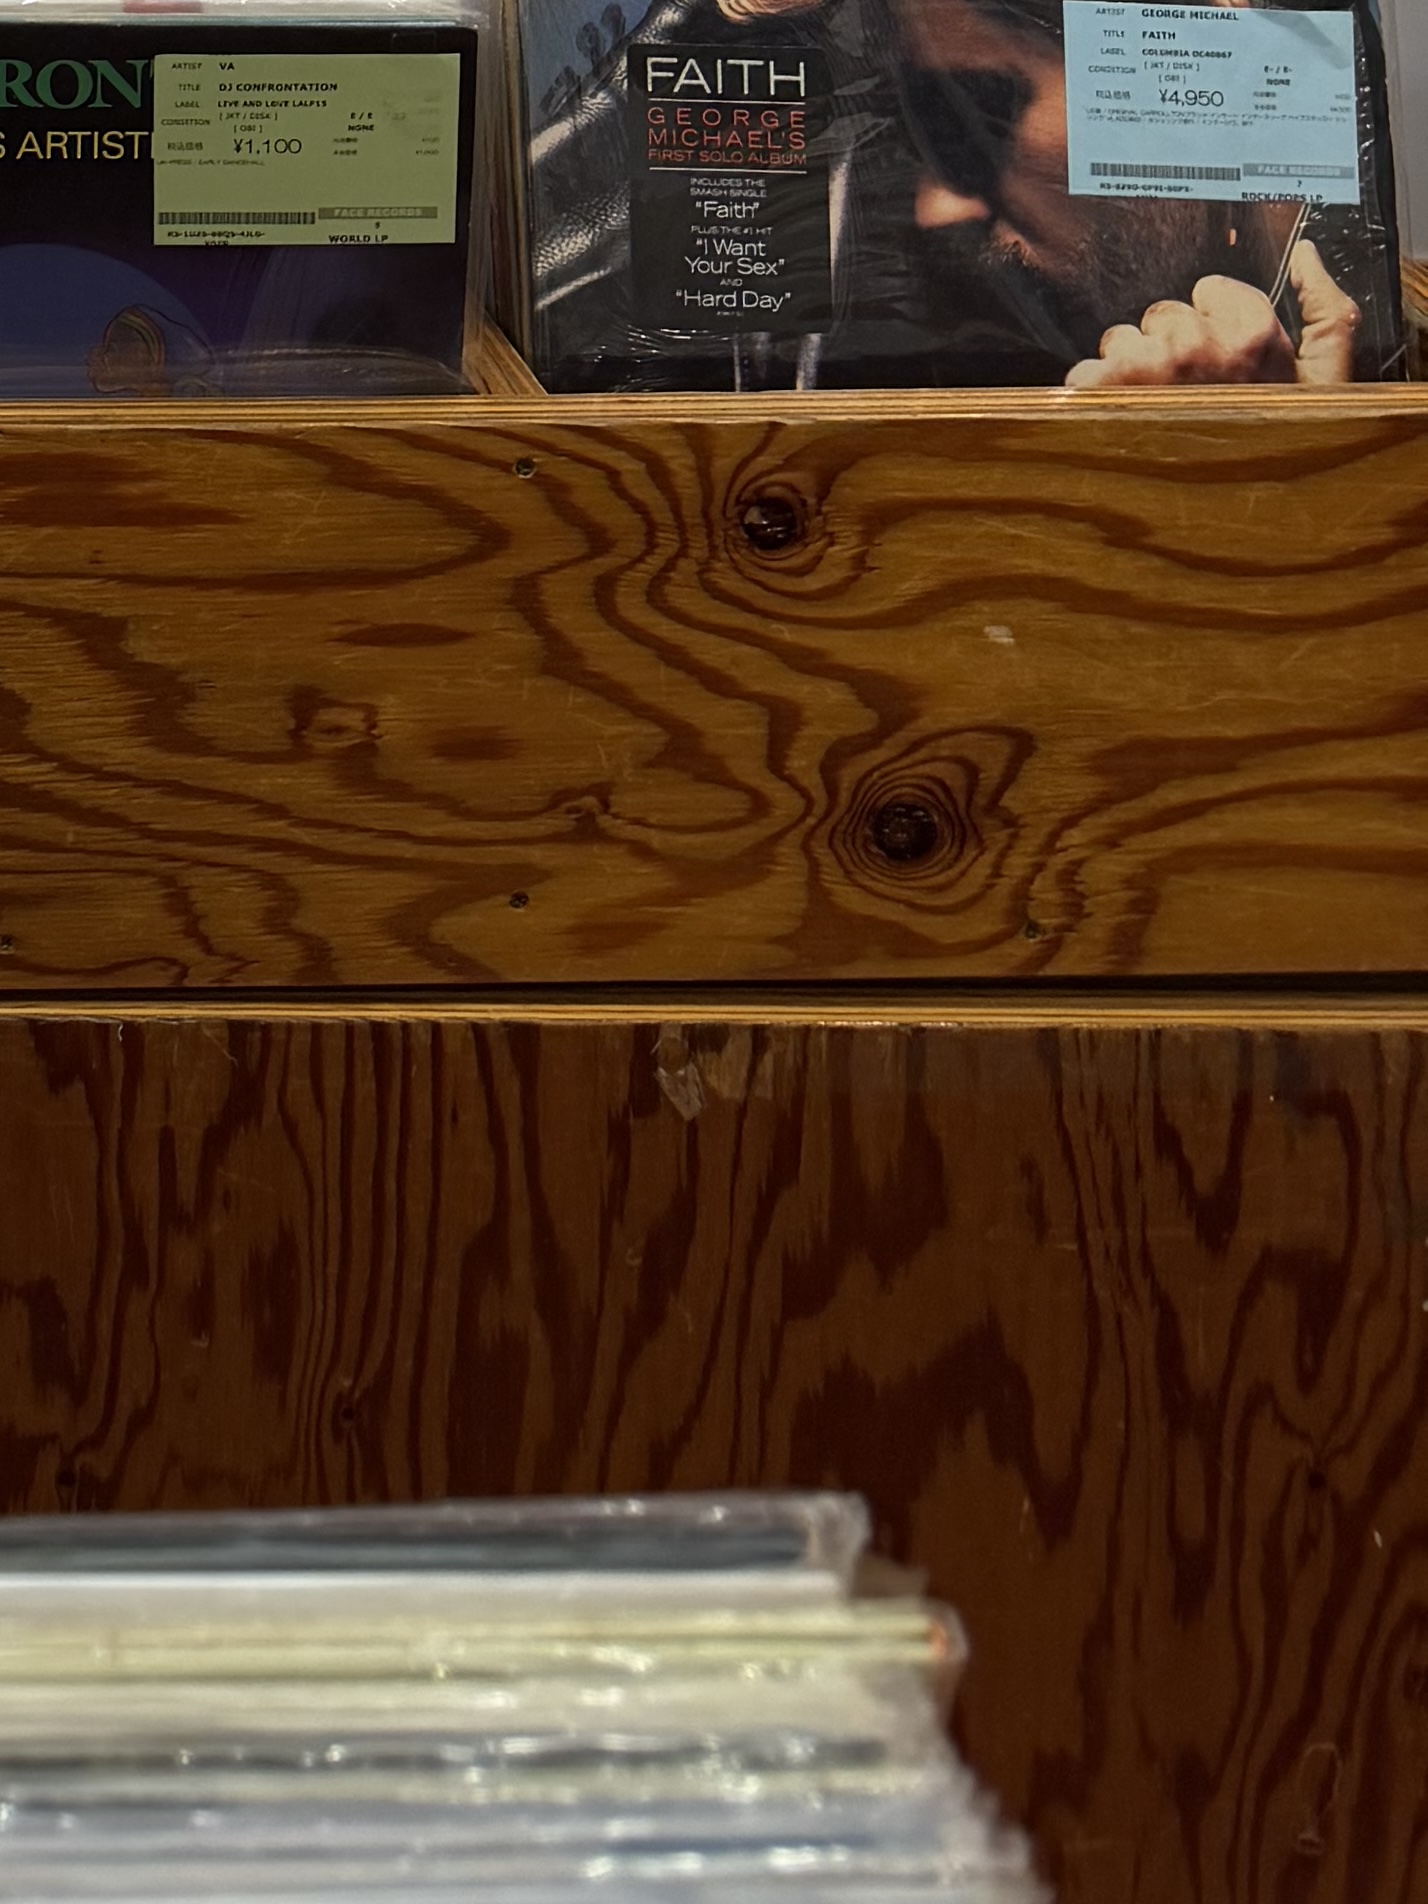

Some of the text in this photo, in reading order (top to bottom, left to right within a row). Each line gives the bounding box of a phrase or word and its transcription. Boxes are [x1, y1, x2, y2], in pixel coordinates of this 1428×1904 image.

[1141, 8, 1239, 21] GEORGE MICHAEL
[1141, 30, 1176, 40] FAITH
[1141, 48, 1190, 58] COLUMBIA
[219, 62, 235, 71] VA
[646, 56, 806, 97] FAITH
[218, 82, 338, 92] DJ CONFRONTATION
[242, 100, 263, 109] AND
[1158, 89, 1224, 108] ¥4,950
[647, 106, 806, 129] GEORGE
[15, 130, 155, 161] ARTIST
[647, 128, 806, 151] MICHAEL'S
[233, 138, 303, 155] ¥1,100
[648, 149, 807, 165] FIRST SOLO ALBUM
[690, 178, 766, 188] INCLUDES THE
[718, 226, 739, 235] THE
[328, 234, 371, 243] WORLD
[713, 239, 767, 256] Want
[684, 256, 732, 274] Your
[719, 278, 743, 287] AND
